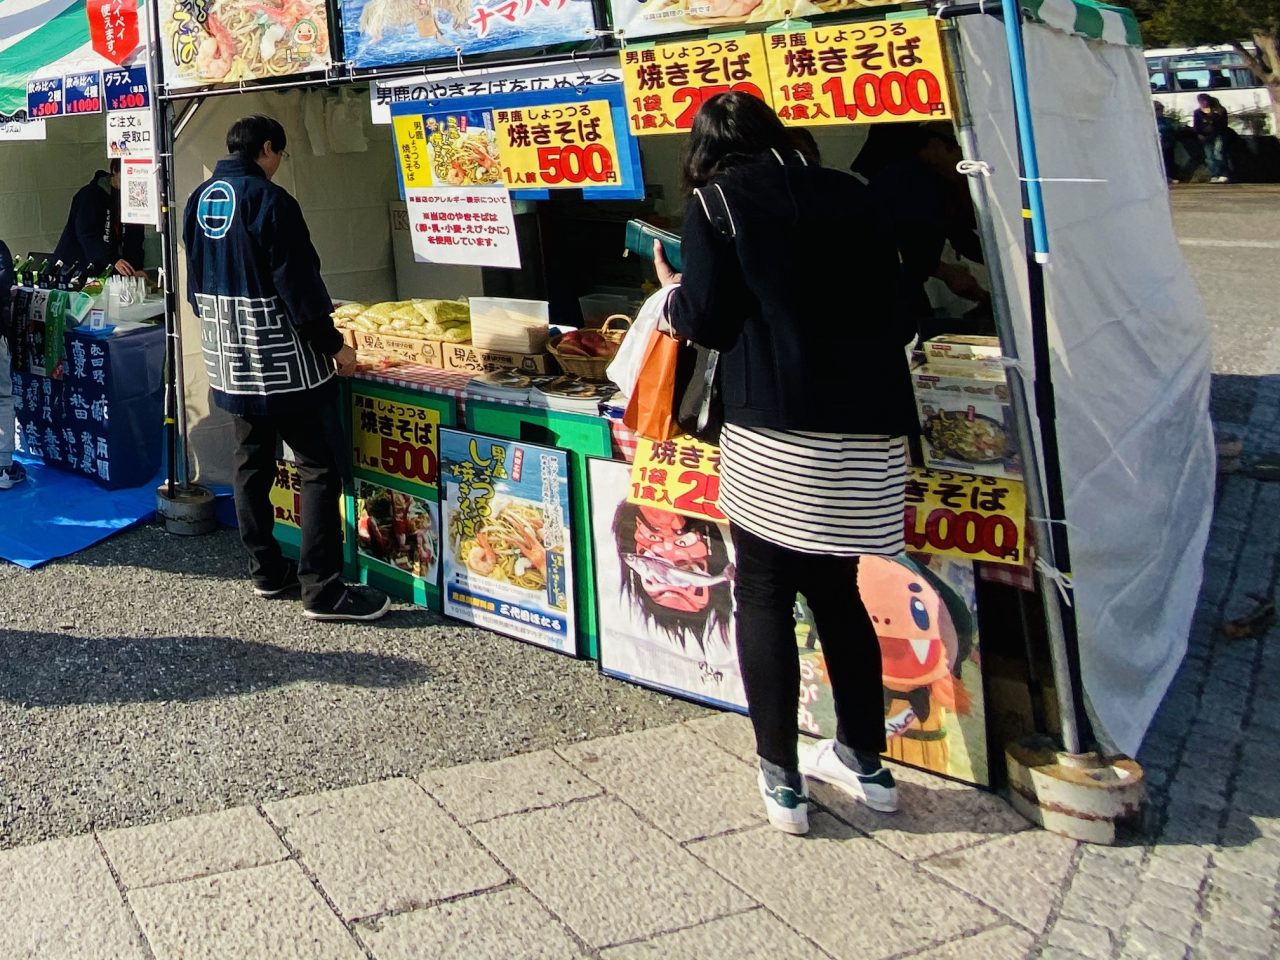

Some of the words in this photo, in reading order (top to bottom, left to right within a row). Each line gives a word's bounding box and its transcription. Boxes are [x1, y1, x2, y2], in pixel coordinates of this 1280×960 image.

[100, 3, 117, 56] 使えます。
[771, 33, 807, 48] 男鹿
[814, 23, 907, 44] しょっつる
[625, 49, 656, 64] 男鹿
[663, 40, 739, 60] しょっつる
[784, 35, 923, 78] 焼きそば
[65, 76, 94, 89] 飲み比べ
[105, 71, 132, 87] グラス
[637, 55, 753, 91] 焼きそば
[28, 81, 57, 94] 飲み比べ
[376, 74, 621, 106] 男鹿のやきそばを広める
[780, 82, 815, 101] 1袋
[32, 101, 59, 116] ¥500
[66, 98, 99, 113] ¥1000
[112, 93, 145, 110] ¥500
[633, 95, 663, 112] 1袋
[497, 111, 524, 124] 男鹿
[528, 104, 591, 120] しょっつる
[631, 113, 674, 130] 1食入
[778, 103, 830, 122] 4食入
[122, 130, 151, 142] 受取口
[507, 116, 603, 149] 焼きそば
[408, 130, 421, 170] しょっつる
[401, 144, 415, 182] 焼きそば
[503, 166, 537, 186] 1人前
[71, 339, 88, 379] 高清水
[378, 401, 427, 420] しょっつる
[361, 411, 432, 445] 焼きそば
[632, 483, 672, 505] 1食入
[904, 478, 1009, 511] きそば
